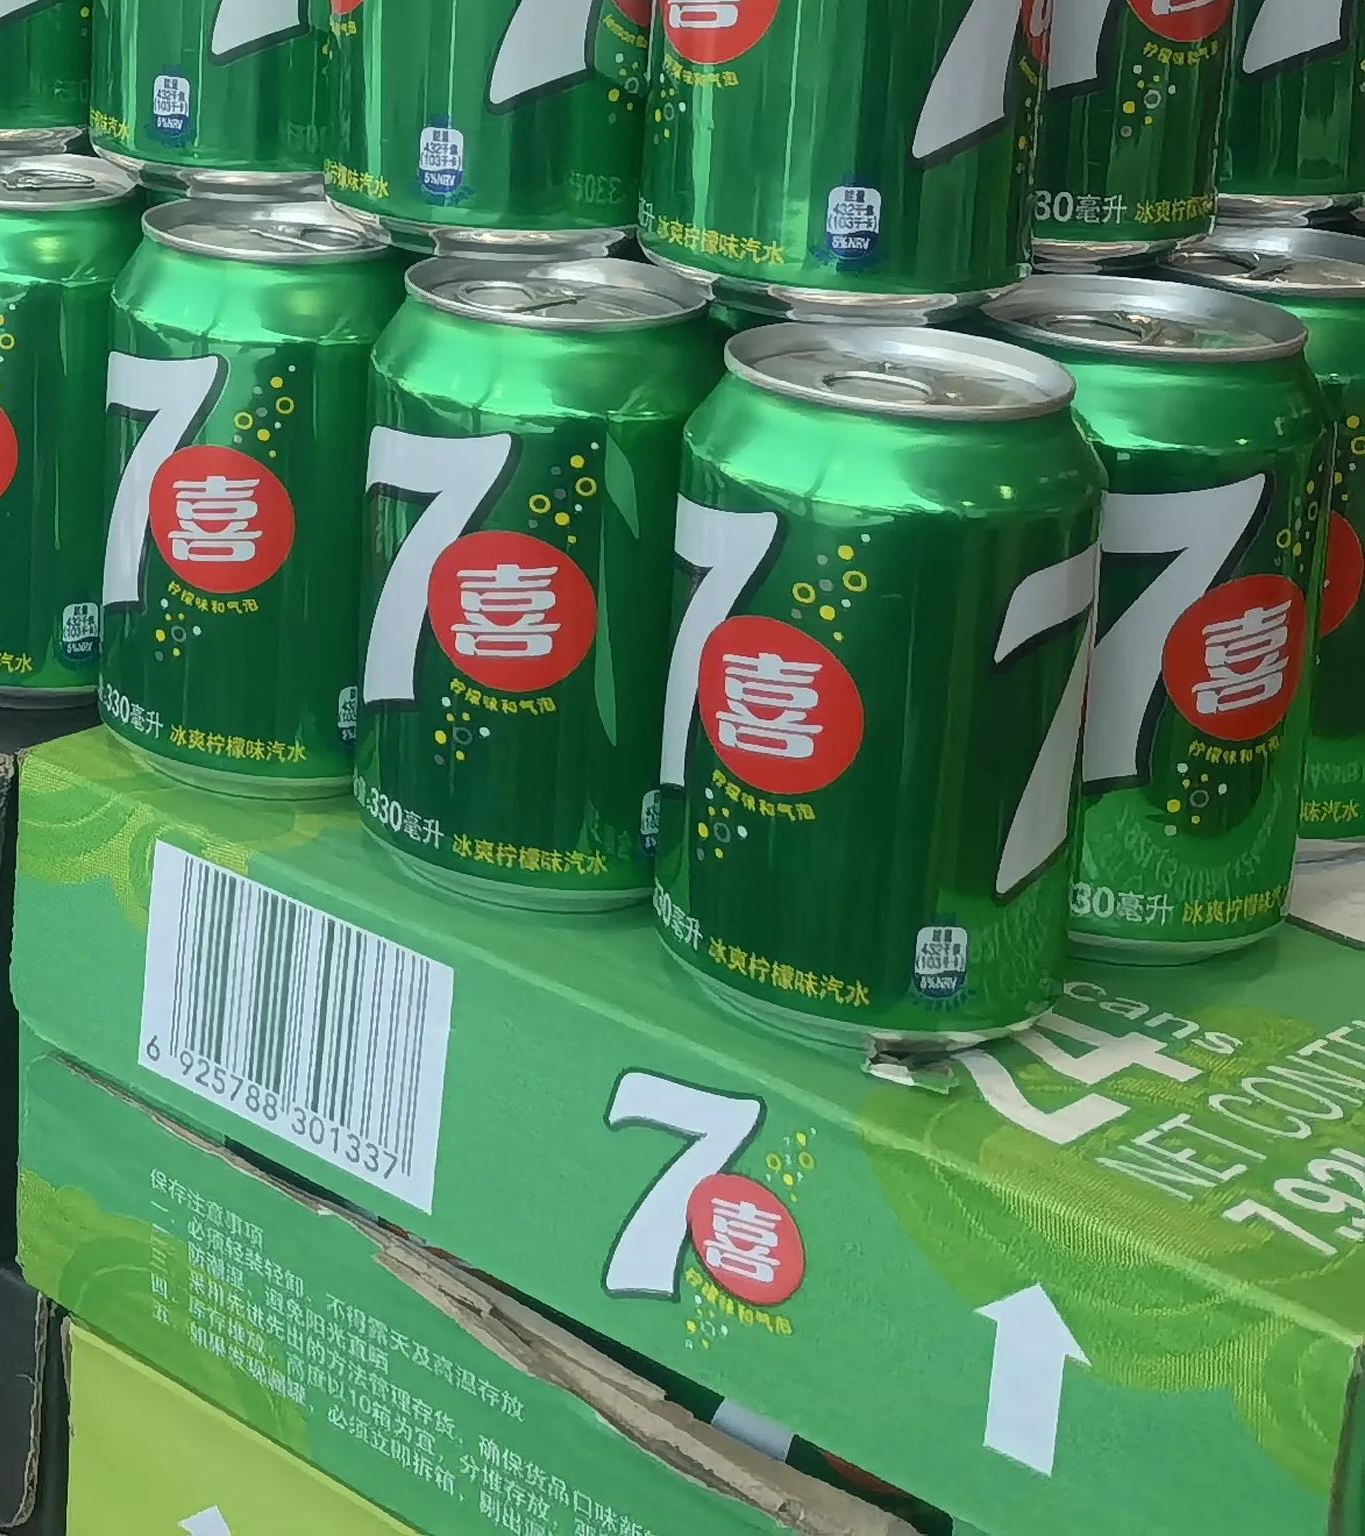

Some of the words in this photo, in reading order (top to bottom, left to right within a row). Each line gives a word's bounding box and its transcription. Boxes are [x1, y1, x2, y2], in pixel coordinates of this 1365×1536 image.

[104, 351, 227, 608] 7
[168, 475, 262, 562] 喜
[364, 426, 513, 704] 7
[449, 563, 560, 658] 喜
[660, 495, 779, 788] 7
[1081, 474, 1267, 785] 7
[1191, 598, 1293, 716] 喜
[169, 723, 308, 764] 冰爽柠檬味汽水
[715, 652, 825, 761] 喜
[994, 542, 1102, 896] 7
[452, 833, 610, 877] 冰爽柠檬味汽水
[708, 936, 872, 1008] 冰爽柠檬味汽水
[1063, 980, 1245, 1056] cans
[145, 1035, 162, 1063] 6
[179, 1049, 278, 1122] 925788
[291, 1107, 399, 1181] 301337
[1095, 1112, 1268, 1203] NET
[1209, 1019, 1365, 1140] CONT
[150, 1167, 265, 1250] 保存注意事项
[606, 1069, 765, 1295] 7
[703, 1197, 782, 1285] 喜
